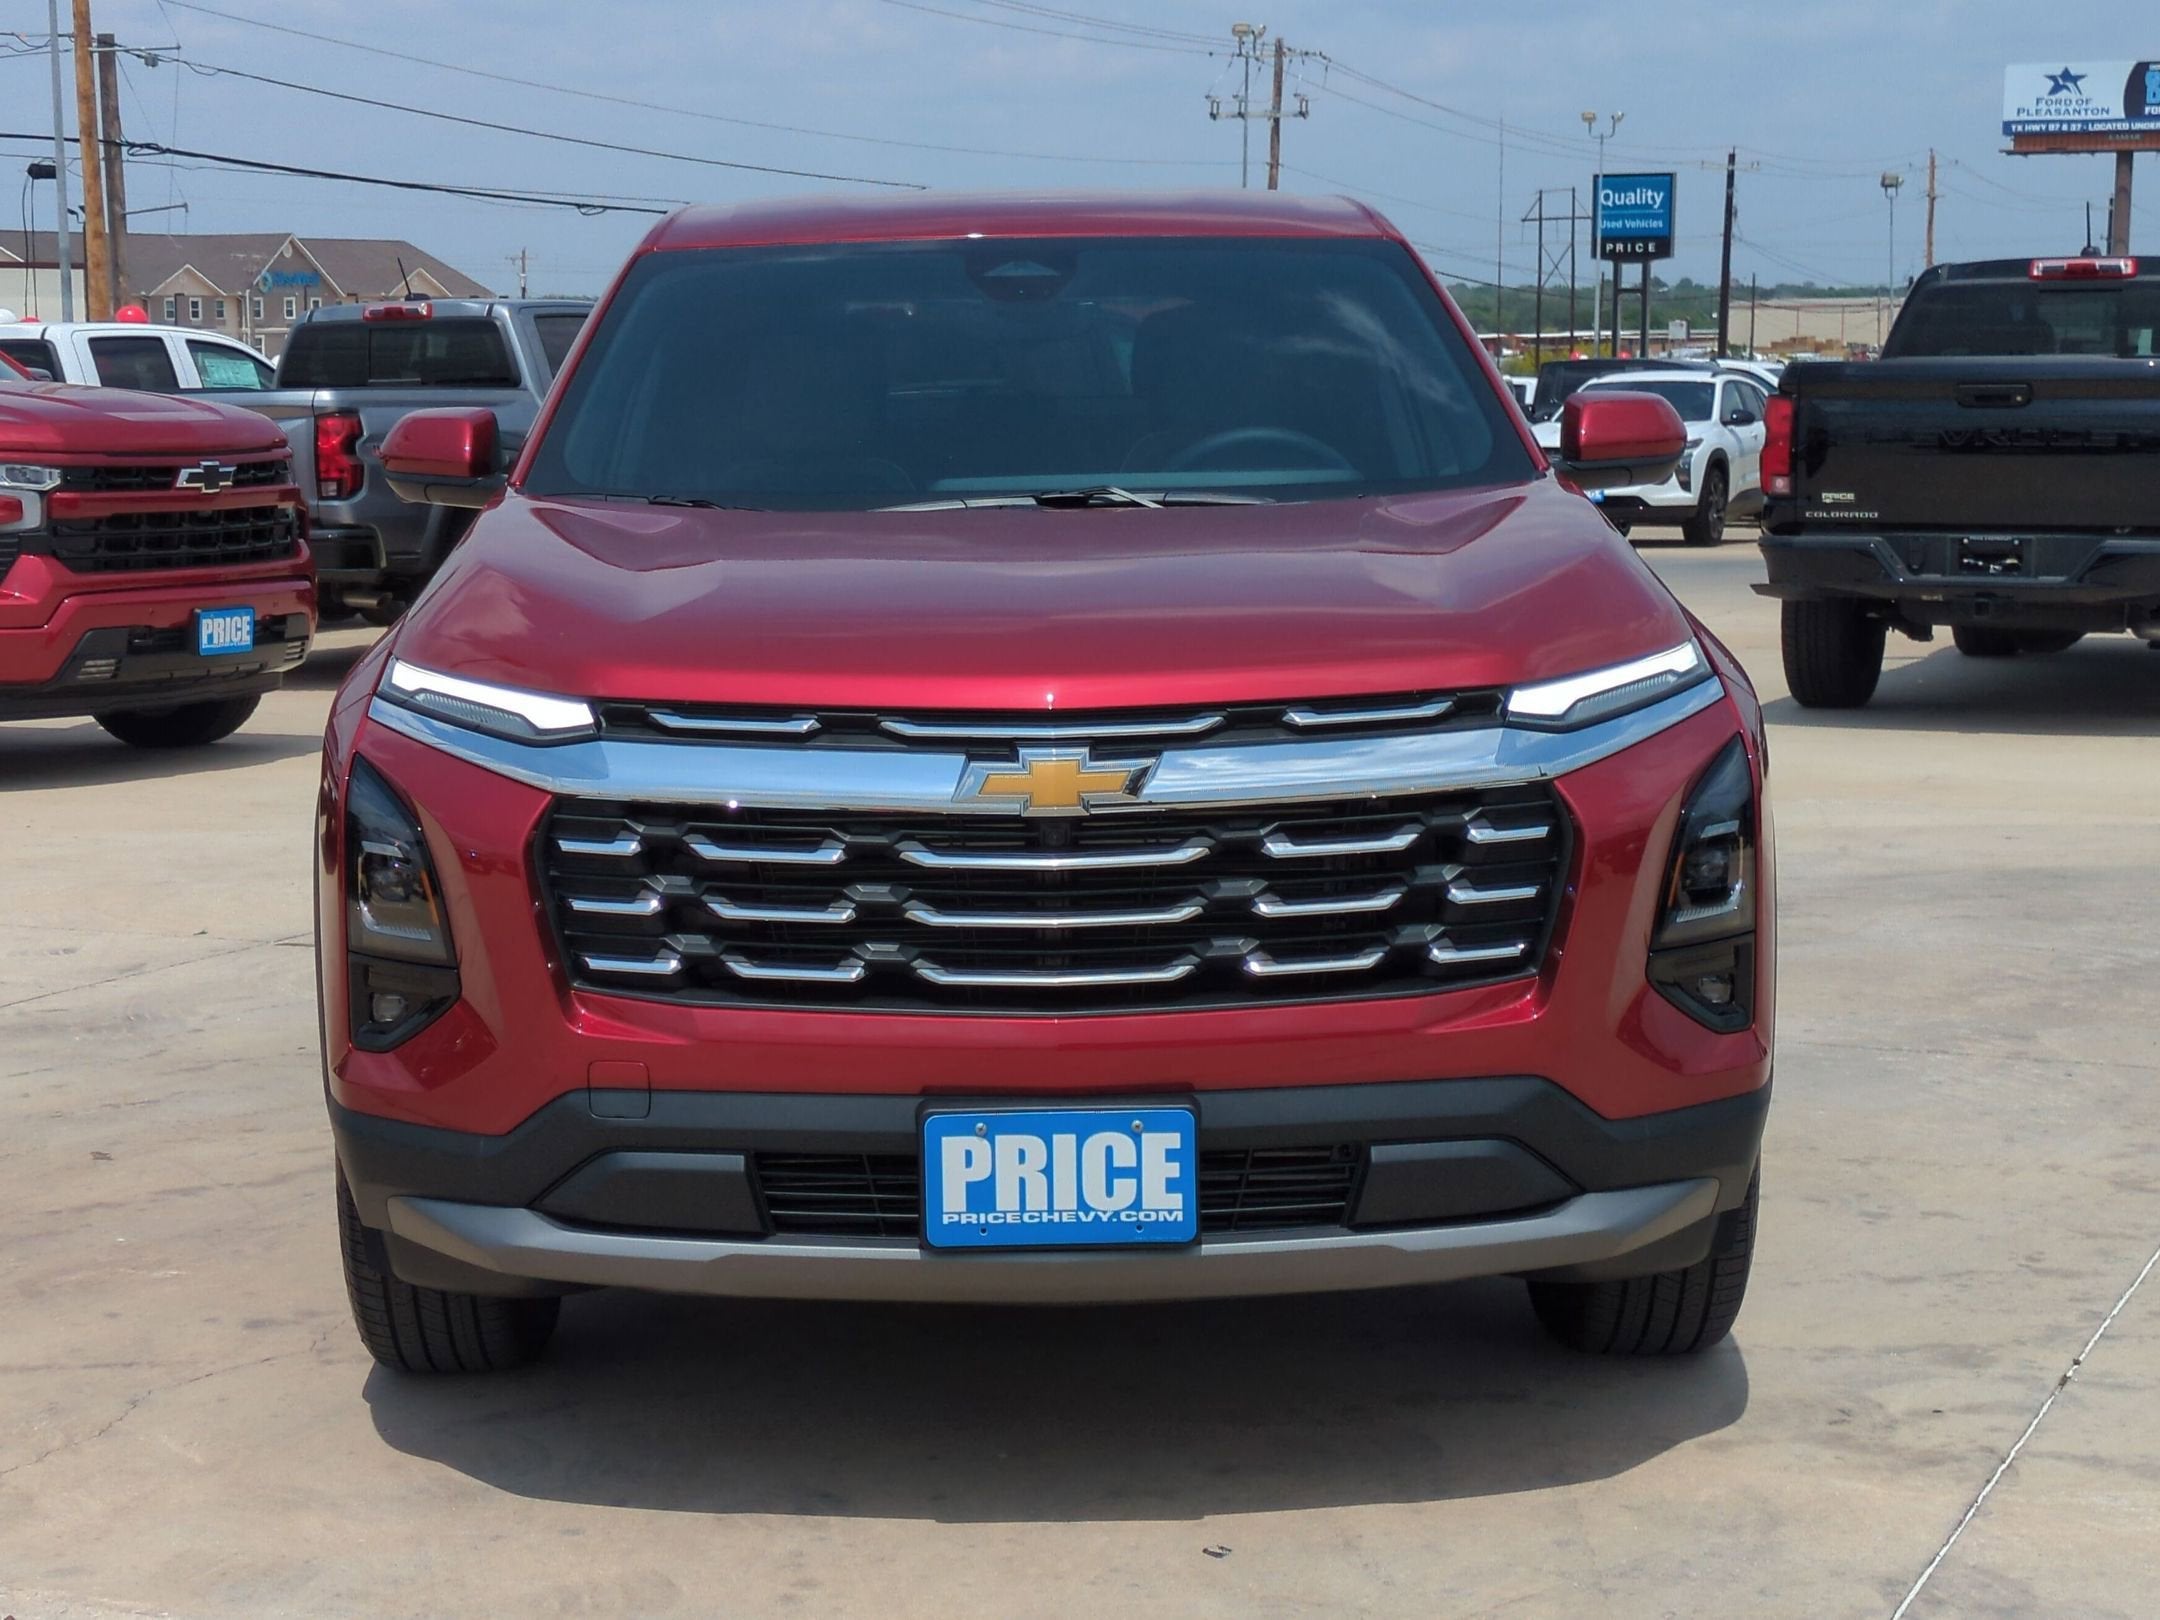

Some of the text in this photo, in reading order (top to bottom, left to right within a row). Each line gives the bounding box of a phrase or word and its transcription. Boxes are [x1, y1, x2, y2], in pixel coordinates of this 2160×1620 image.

[2036, 97, 2093, 106] FORD OF
[2017, 107, 2110, 117] PLEASANTON
[2011, 123, 2023, 132] TX
[2025, 123, 2046, 132] HWY
[2088, 122, 2129, 131] LOCATED
[1601, 188, 1664, 209] Quality
[1624, 218, 1664, 228] Vehicles
[1606, 242, 1656, 253] PRICE
[1822, 492, 1855, 500] PRICE
[202, 616, 251, 645] PRICE
[941, 1132, 1183, 1212] PRICE
[942, 1210, 1183, 1225] PRICECHEVY.COM
